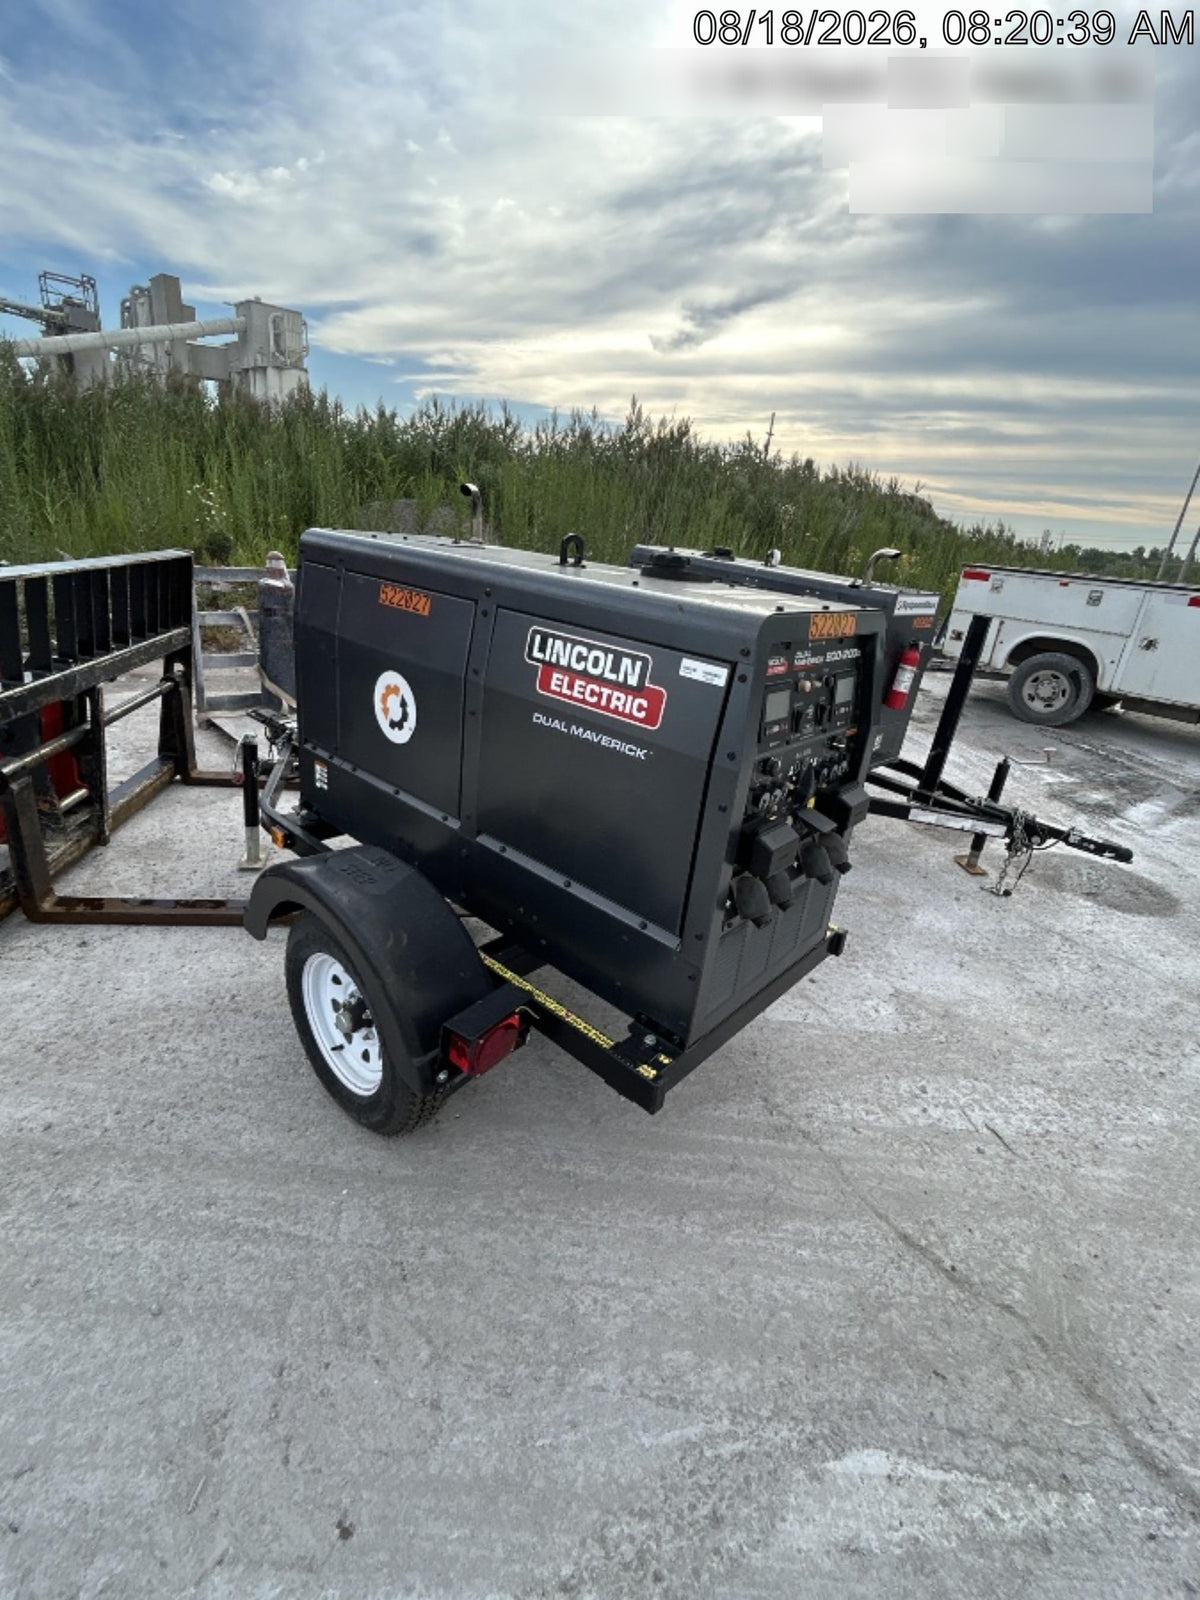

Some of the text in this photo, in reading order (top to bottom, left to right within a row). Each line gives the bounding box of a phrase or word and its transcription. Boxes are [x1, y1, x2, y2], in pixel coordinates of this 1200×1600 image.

[532, 633, 642, 687] LINCOLN
[550, 673, 648, 719] ELECTRIC
[532, 712, 647, 760] DUAL MAVERICK
